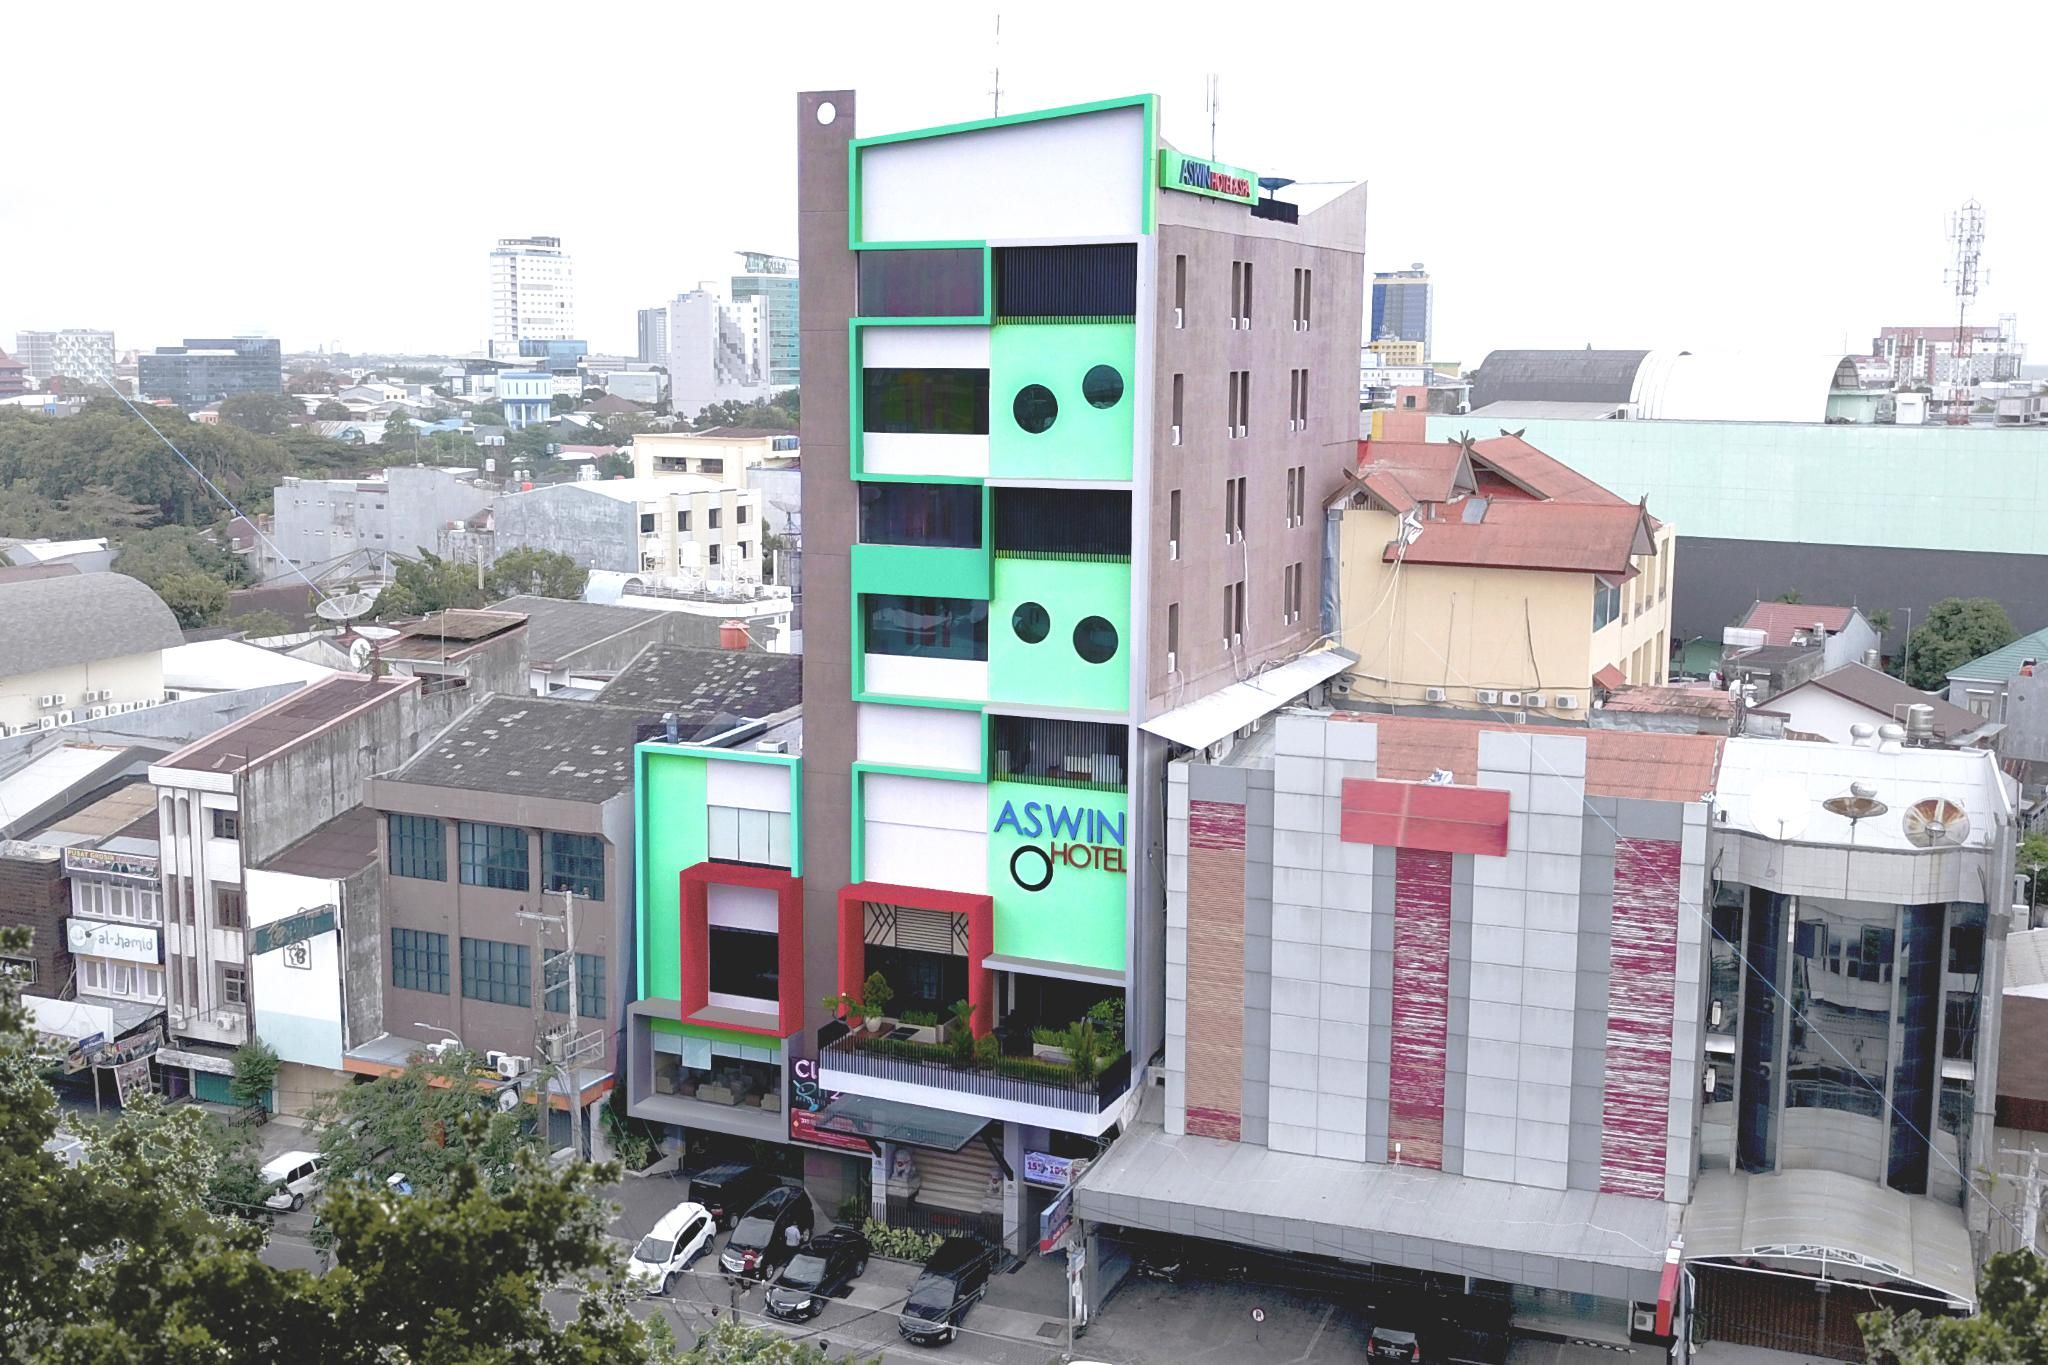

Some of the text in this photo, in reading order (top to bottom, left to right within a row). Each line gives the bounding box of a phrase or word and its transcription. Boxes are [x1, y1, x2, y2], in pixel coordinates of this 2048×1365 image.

[1179, 159, 1211, 190] ASWIN
[993, 799, 1125, 846] ASWIN
[67, 849, 89, 858] PUSAT
[1050, 841, 1127, 873] HOTEL
